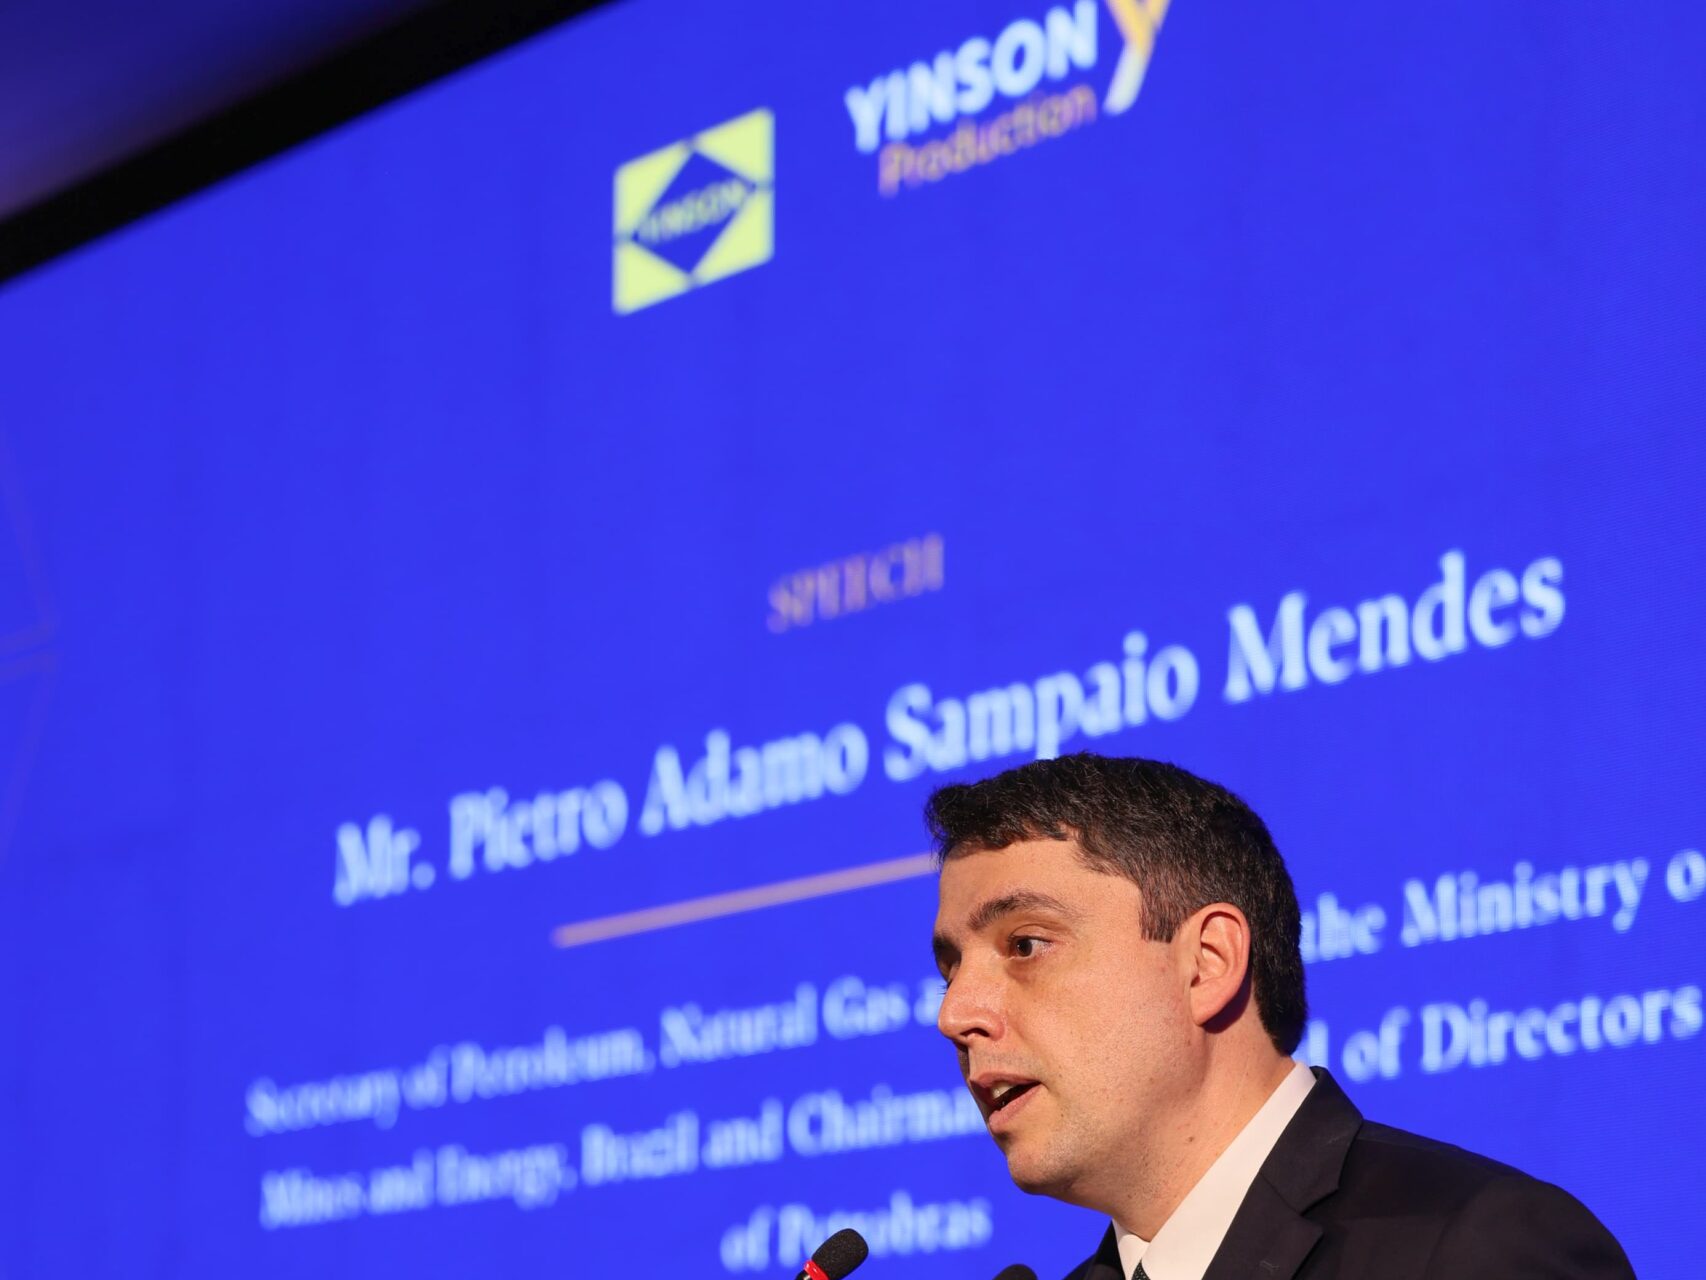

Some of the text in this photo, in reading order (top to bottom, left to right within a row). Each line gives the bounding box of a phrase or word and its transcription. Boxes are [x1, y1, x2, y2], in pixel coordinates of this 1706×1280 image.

[844, 0, 1098, 154] YINSON
[878, 84, 1098, 198] Production
[767, 533, 944, 633] SPEECH
[334, 548, 1565, 907] Mr. Pietro Adamo Sampaio Mendes
[660, 981, 818, 1068] Natural
[823, 976, 911, 1040] Gas
[1300, 892, 1387, 963] the
[1401, 860, 1650, 948] Ministry
[1666, 849, 1706, 902] o
[703, 1098, 784, 1168] and
[788, 1083, 990, 1156] Chairma
[1343, 1006, 1411, 1083] of
[1420, 985, 1703, 1075] Directors
[720, 1204, 774, 1271] of
